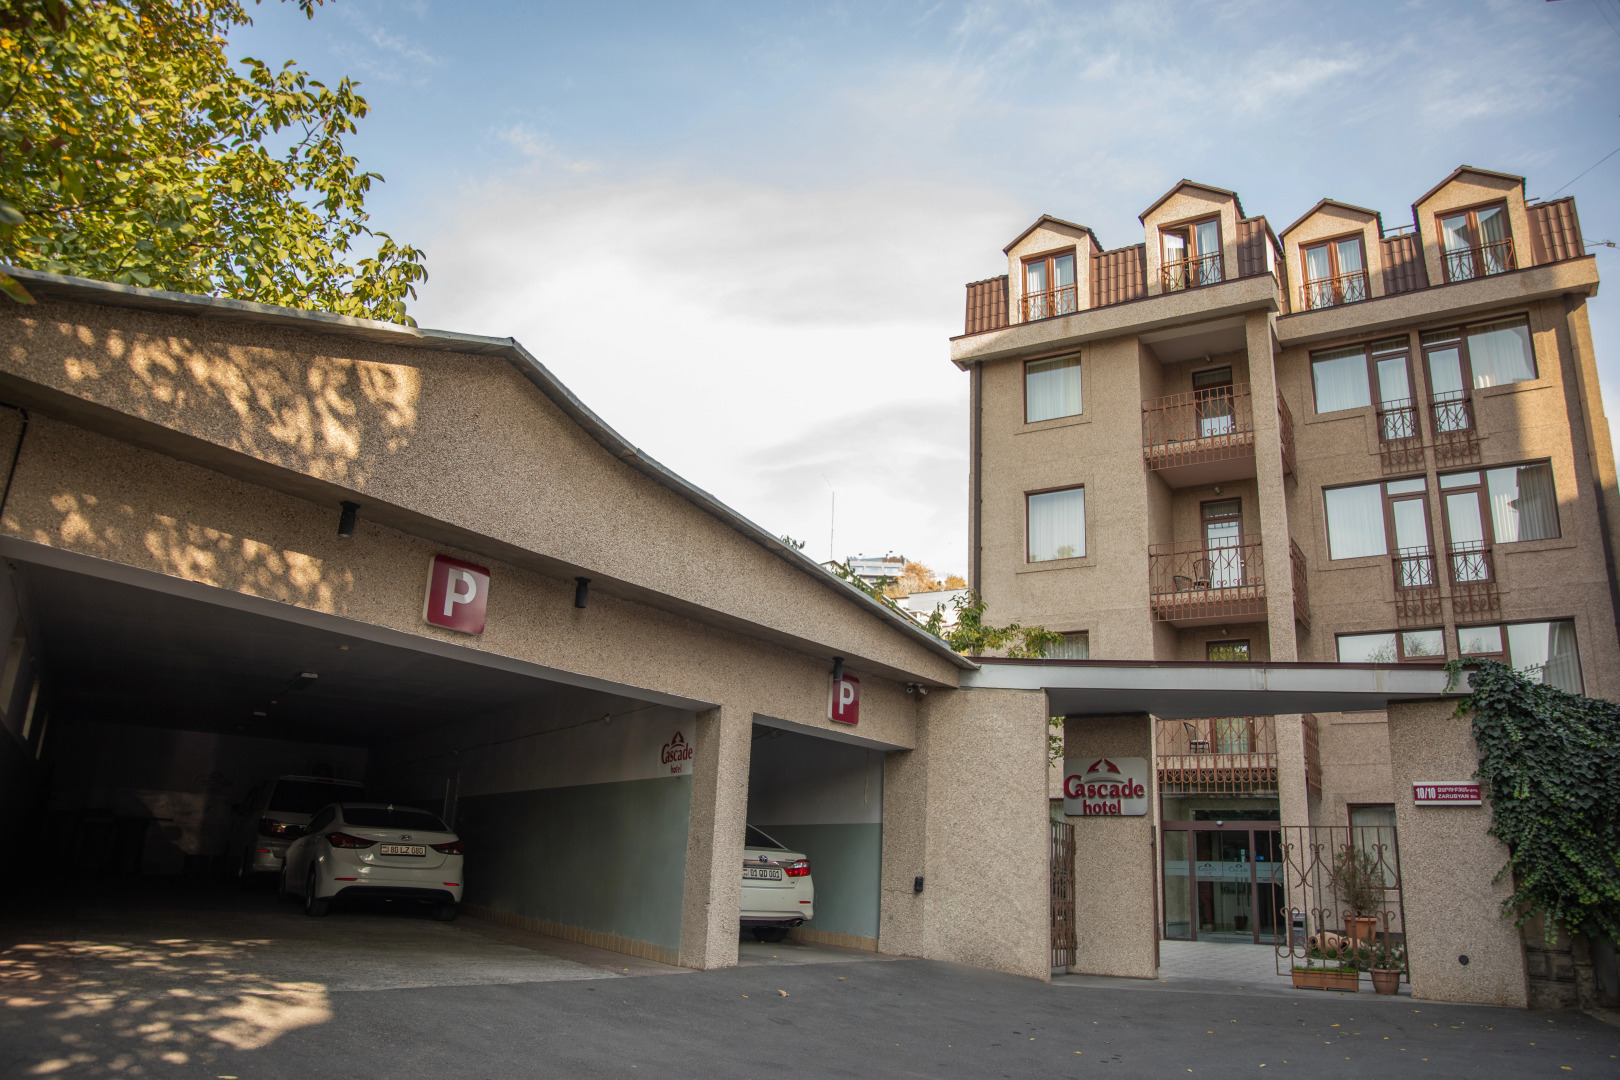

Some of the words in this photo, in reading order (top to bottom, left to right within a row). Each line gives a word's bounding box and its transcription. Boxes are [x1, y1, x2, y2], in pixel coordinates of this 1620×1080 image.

[443, 567, 477, 617] P
[839, 680, 854, 715] P
[661, 742, 693, 765] Cascade
[1064, 774, 1145, 799] Cascade
[1416, 787, 1436, 799] 10/10
[1083, 799, 1122, 815] hotel
[750, 869, 758, 877] 01
